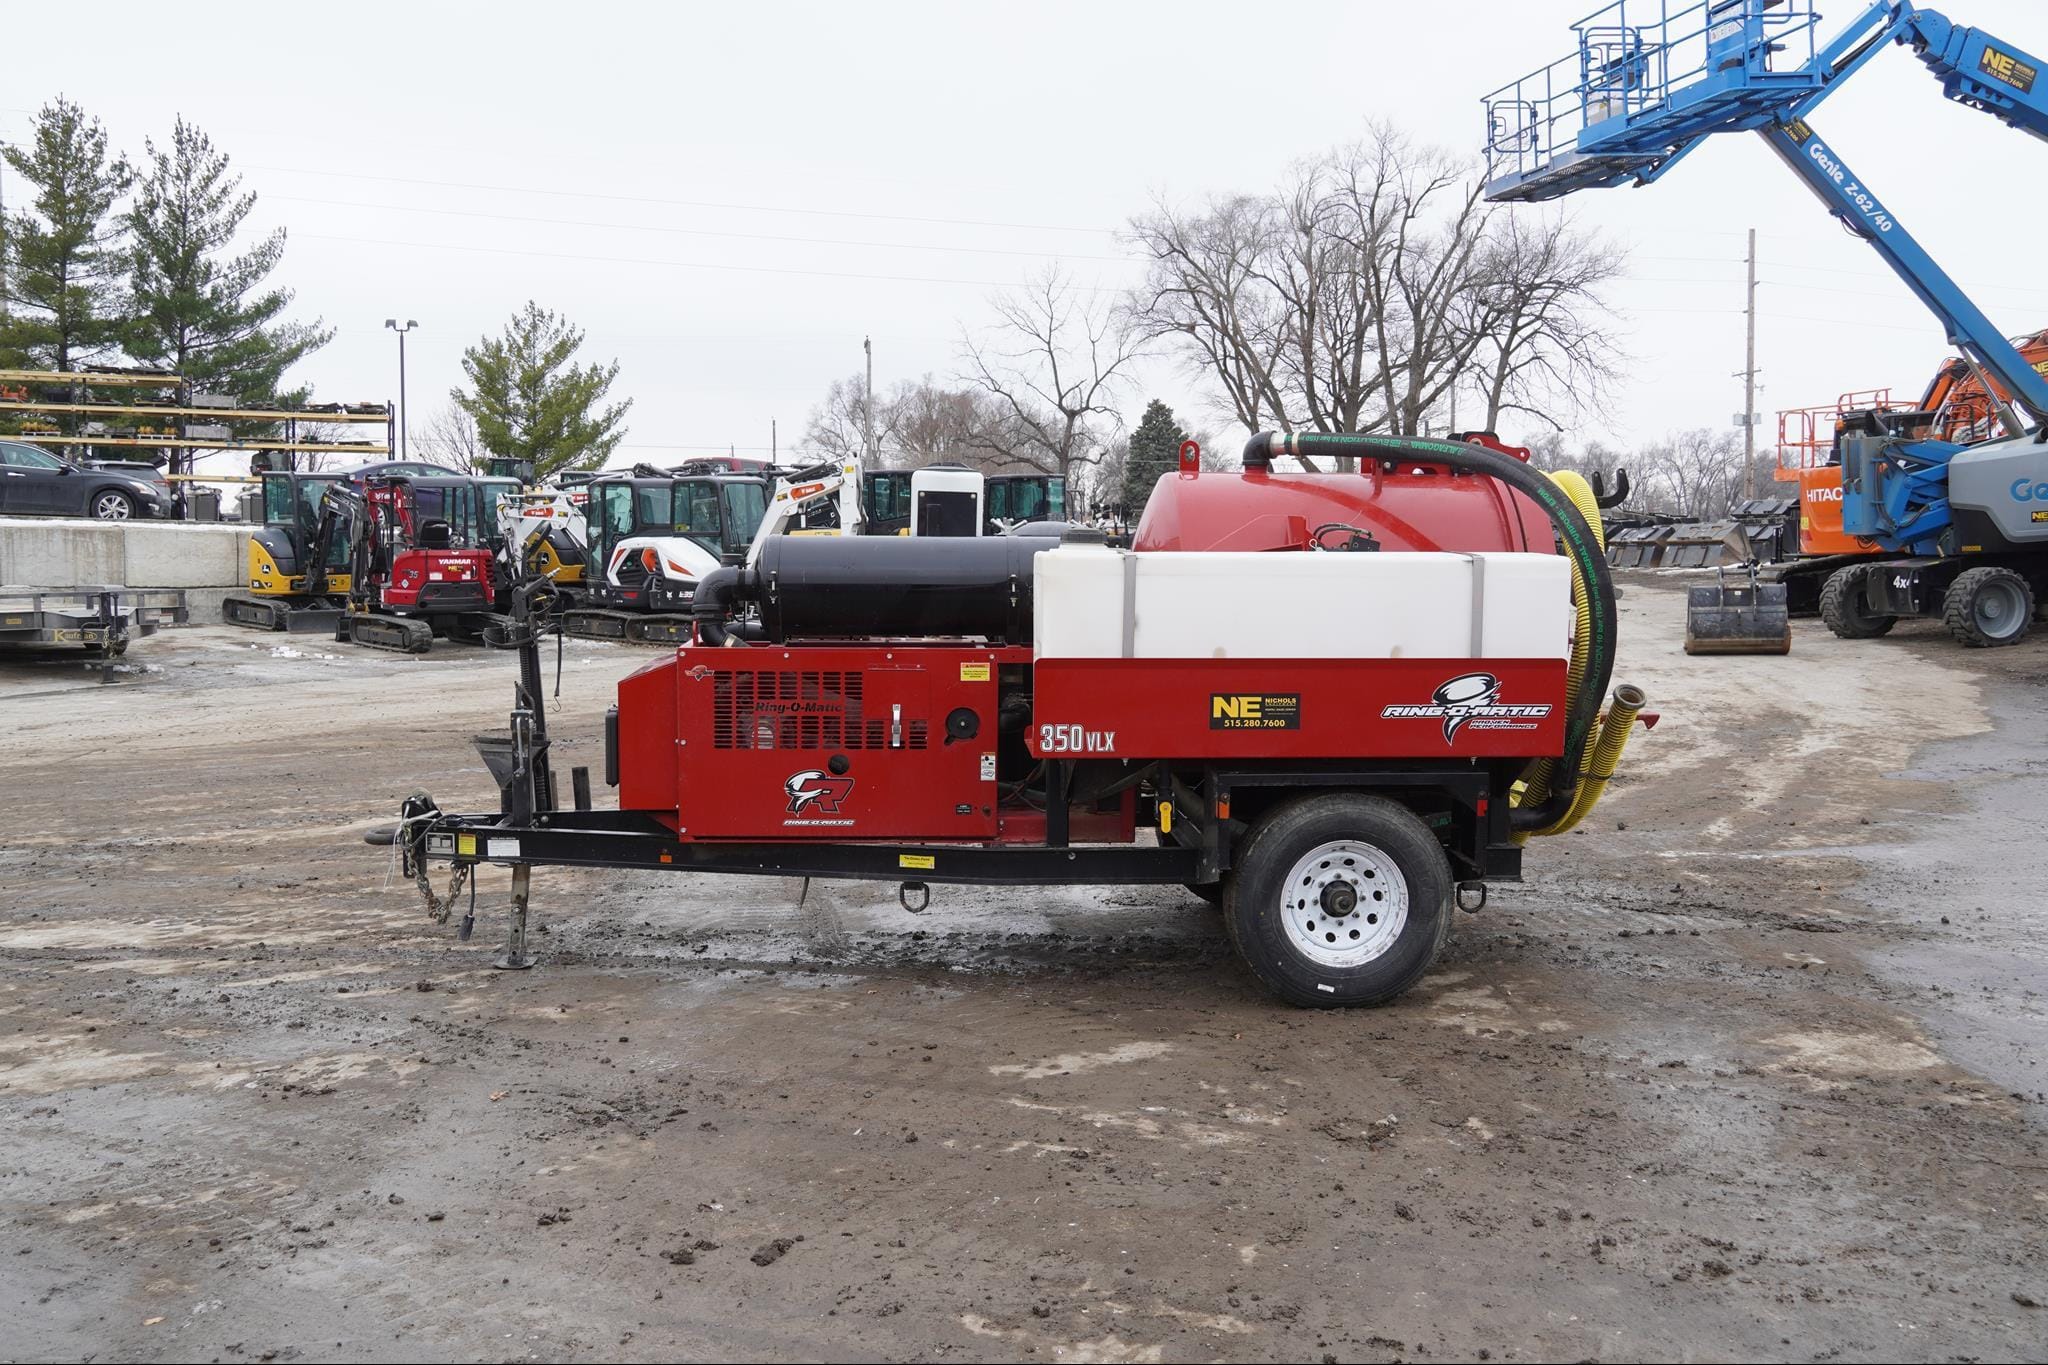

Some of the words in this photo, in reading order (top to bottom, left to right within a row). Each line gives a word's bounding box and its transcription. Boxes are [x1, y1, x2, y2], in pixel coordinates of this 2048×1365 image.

[1982, 47, 2015, 75] NE
[1809, 143, 1845, 185] Genie
[1844, 182, 1892, 232] Z-62/40
[1556, 508, 1583, 546] PURPOSE
[1578, 544, 1598, 585] GENERAL
[755, 702, 842, 713] Ring-O-Matic
[1213, 696, 1262, 718] NE
[1381, 704, 1552, 718] RING-O-MATIC
[1224, 719, 1286, 727] 515.280.7600
[1040, 723, 1085, 752] 350
[1085, 731, 1116, 752] VLX
